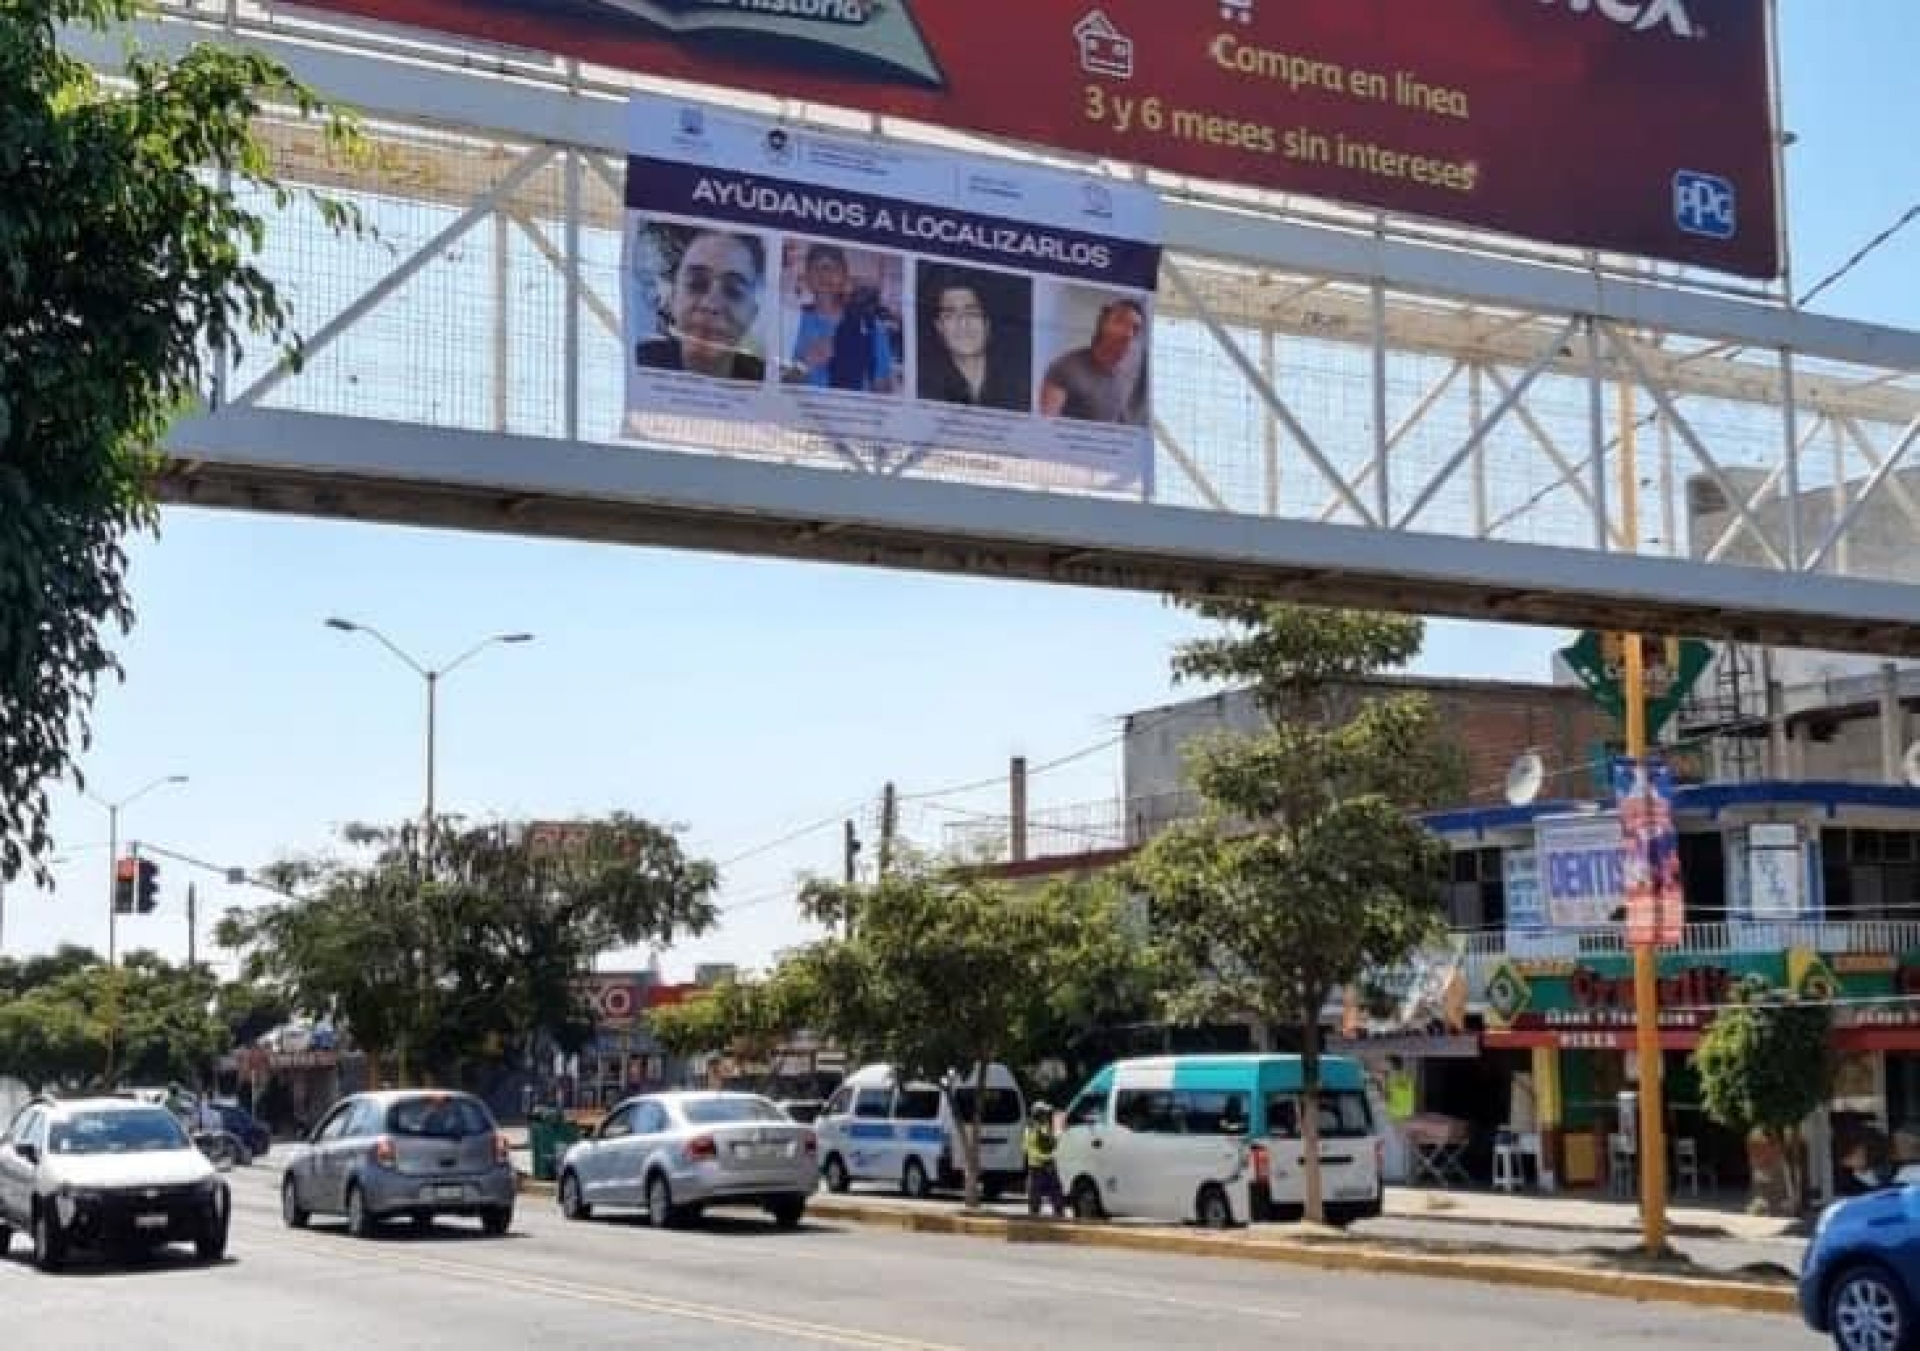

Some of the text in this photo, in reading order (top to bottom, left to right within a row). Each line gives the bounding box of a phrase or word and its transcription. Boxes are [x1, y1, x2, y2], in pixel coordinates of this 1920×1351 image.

[1213, 33, 1470, 118] Compra en línea
[1085, 85, 1477, 190] 3 y 6 meses sin intereses
[692, 178, 1111, 268] AYÚDANOS A LOCALIZARLOS
[1678, 178, 1732, 225] PPG
